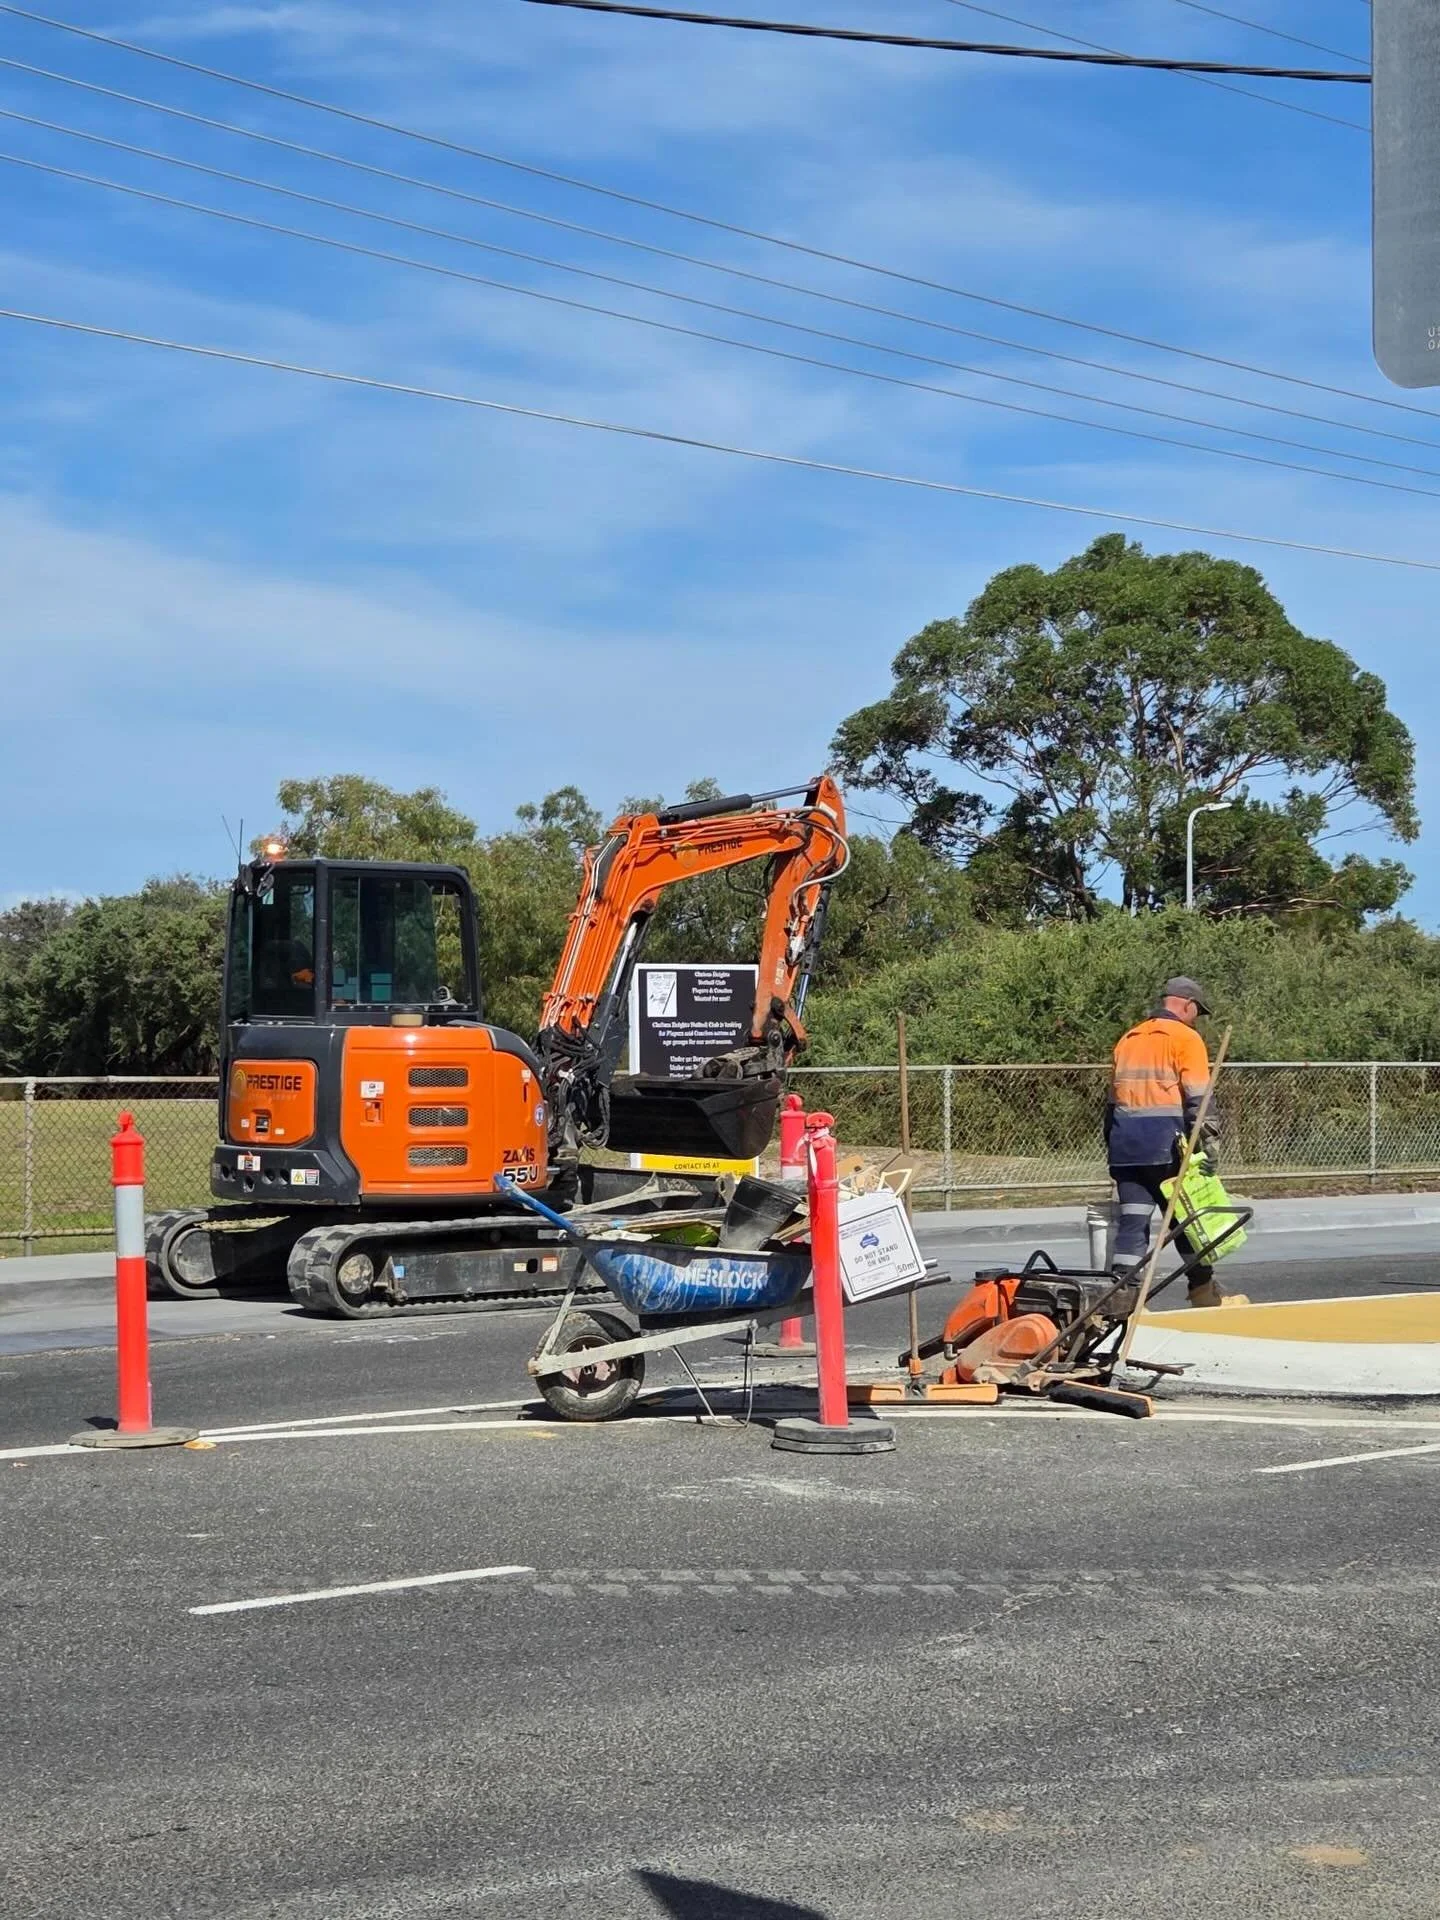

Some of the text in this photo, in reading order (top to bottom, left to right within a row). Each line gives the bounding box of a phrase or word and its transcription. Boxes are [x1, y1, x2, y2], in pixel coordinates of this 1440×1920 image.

[698, 836, 742, 856] PRESTIGE
[247, 1075, 302, 1091] PRESTIGE
[502, 1164, 539, 1183] 55U
[877, 1244, 899, 1256] STAND
